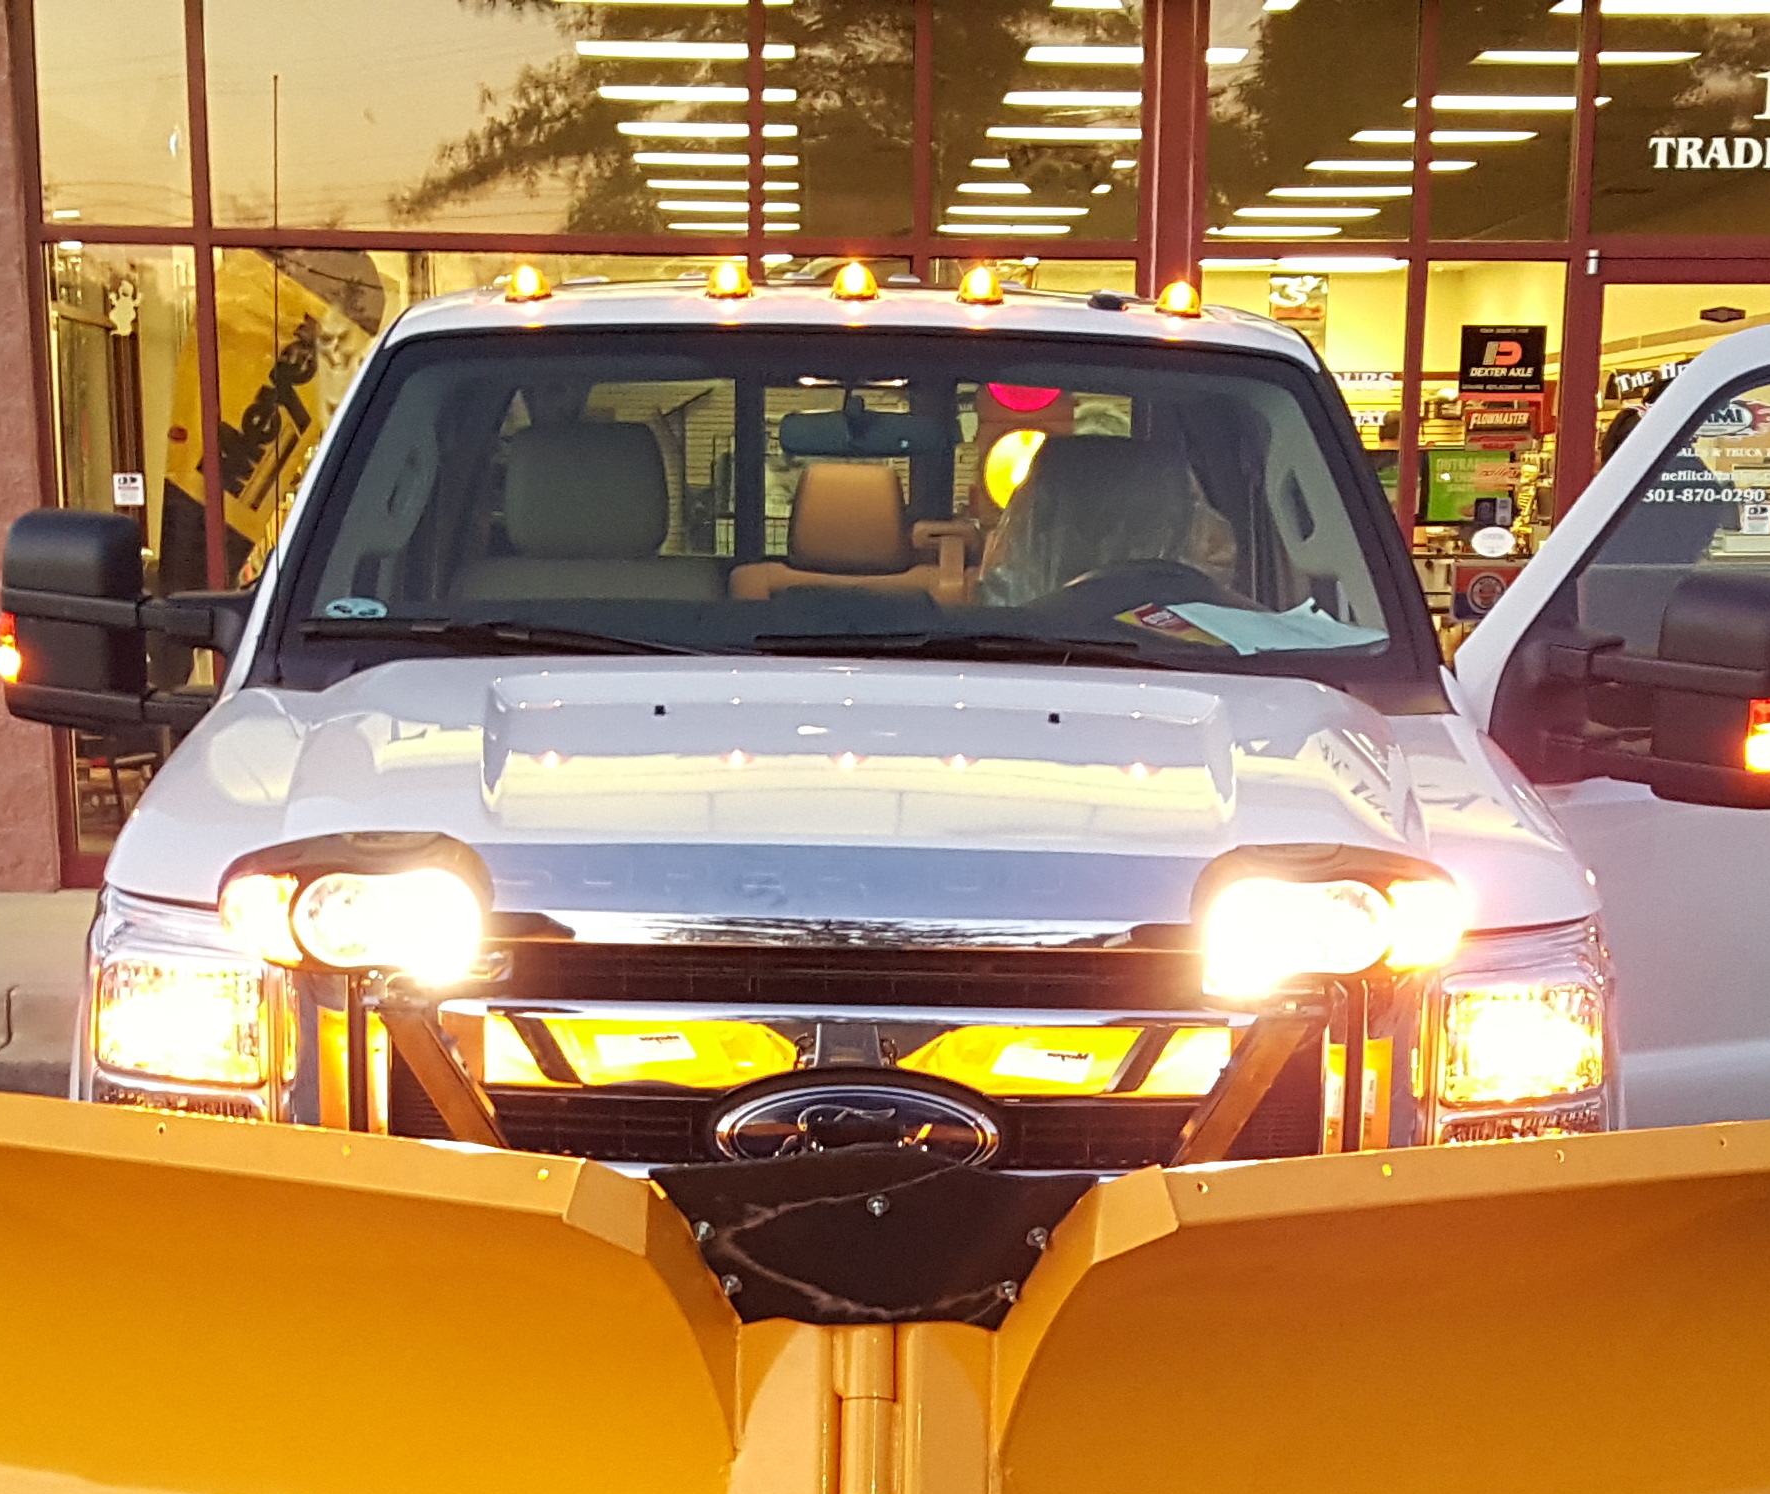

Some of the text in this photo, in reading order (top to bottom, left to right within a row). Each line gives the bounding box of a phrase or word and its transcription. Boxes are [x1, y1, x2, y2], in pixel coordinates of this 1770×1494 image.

[1469, 366, 1535, 378] DEXTER AXLE
[1616, 372, 1655, 393] THE
[1469, 412, 1531, 430] FLOWMASTER
